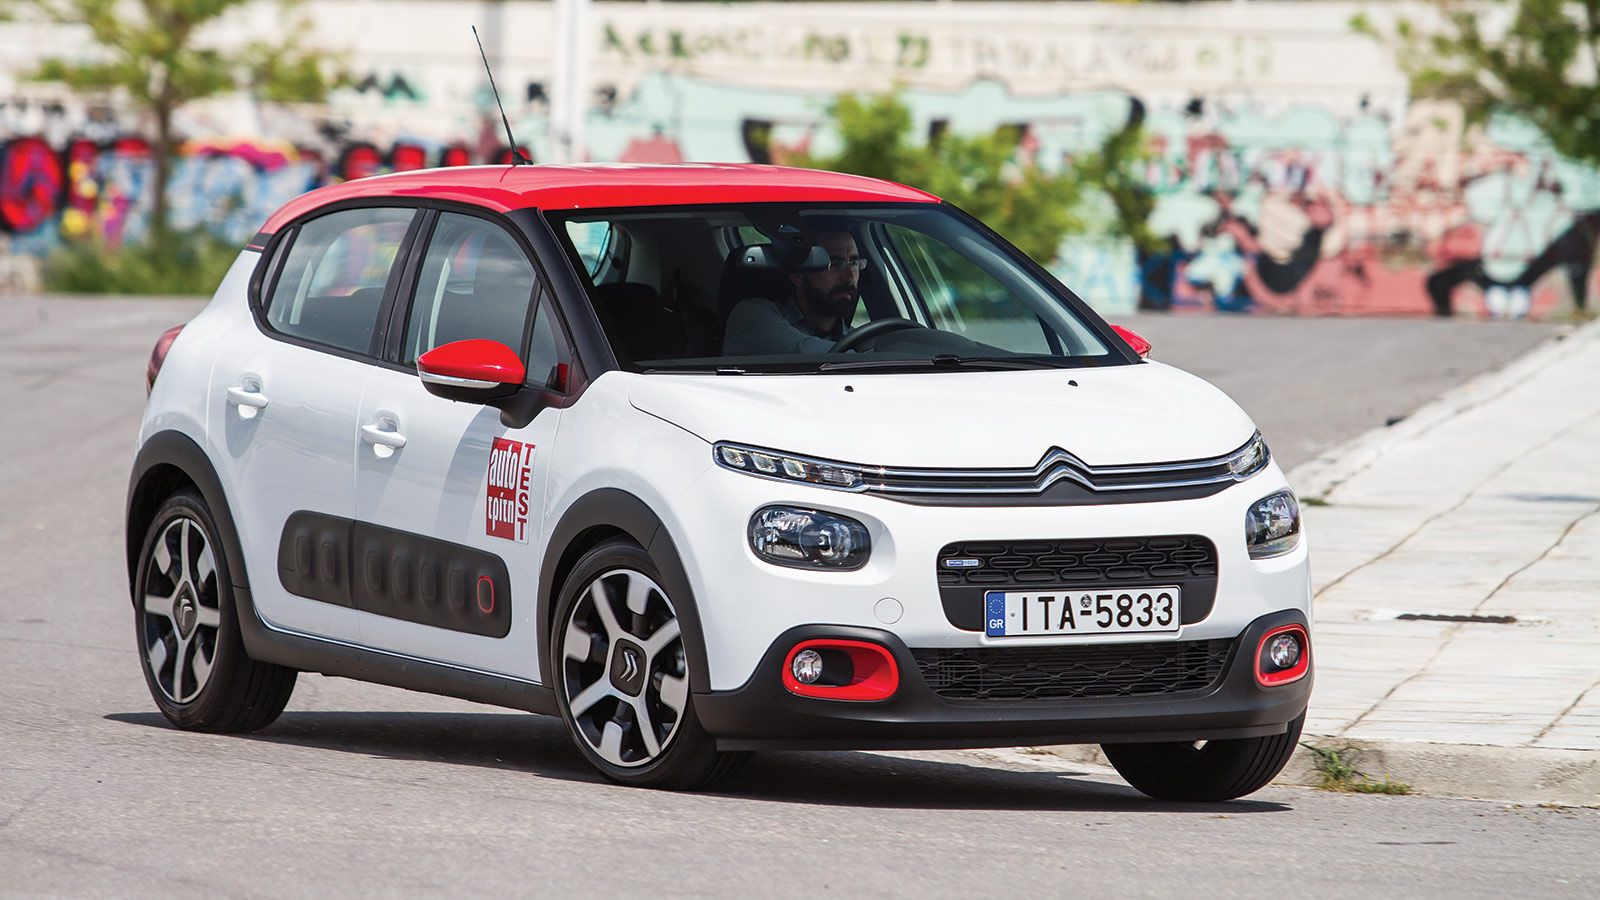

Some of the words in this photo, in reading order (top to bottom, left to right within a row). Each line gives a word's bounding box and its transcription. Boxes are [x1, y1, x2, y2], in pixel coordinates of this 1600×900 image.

[489, 443, 519, 490] auto
[517, 443, 536, 541] TEST
[989, 619, 1005, 630] GR
[1021, 592, 1174, 632] ITA-5833
